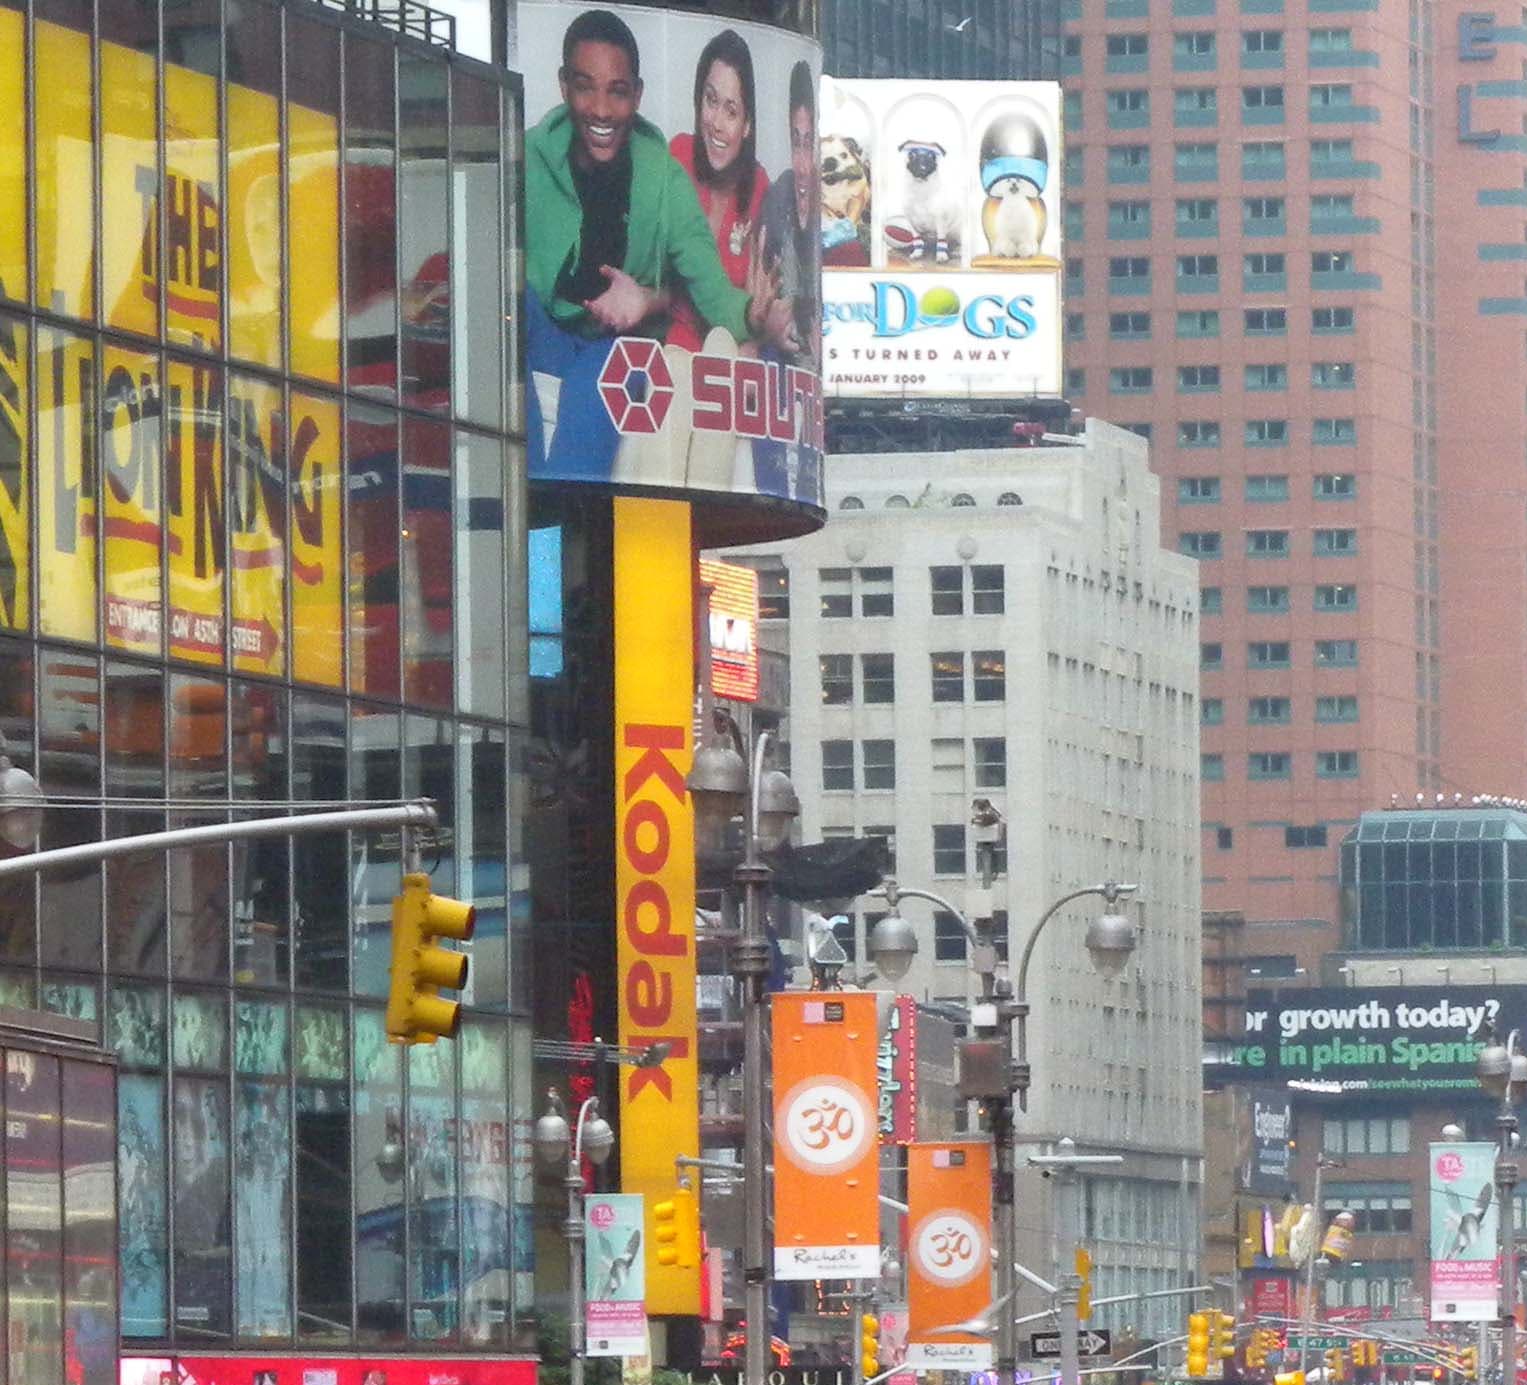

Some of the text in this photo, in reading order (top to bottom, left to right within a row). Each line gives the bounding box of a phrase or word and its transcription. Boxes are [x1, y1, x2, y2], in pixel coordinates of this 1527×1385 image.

[135, 163, 221, 291] THE
[853, 348, 938, 361] TURNED
[953, 350, 1011, 361] AWAY
[829, 373, 926, 385] JANUARY 2009
[52, 285, 324, 580] LION KING
[172, 612, 190, 640] ON
[623, 723, 689, 1104] Kodak
[1279, 1000, 1394, 1037] growth
[1397, 999, 1500, 1032] today?
[1280, 1039, 1307, 1066] in
[1312, 1037, 1387, 1071] plain
[1391, 1035, 1488, 1070] Spanis
